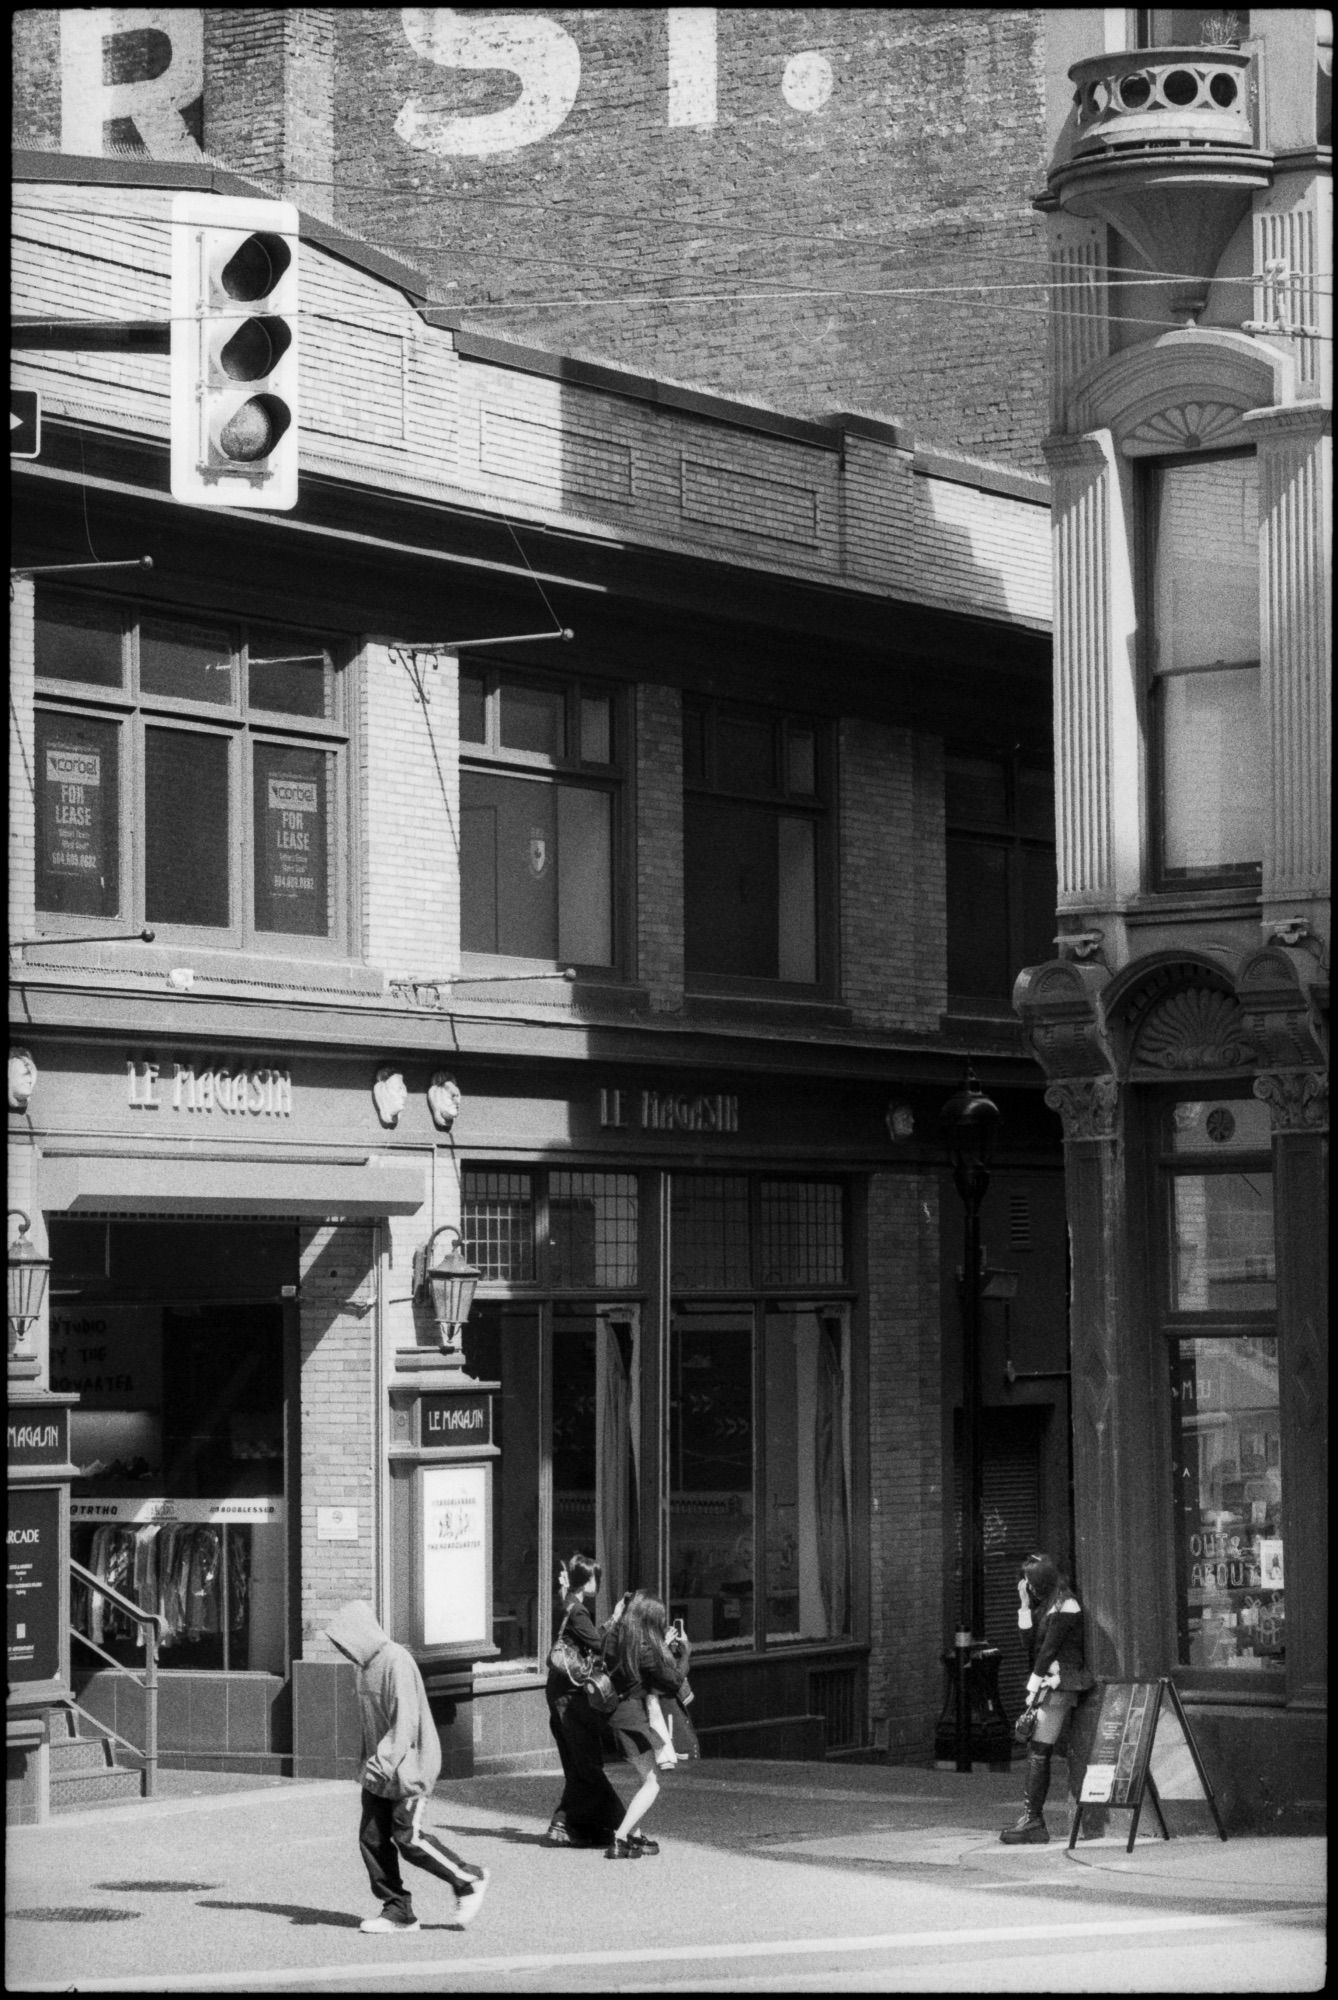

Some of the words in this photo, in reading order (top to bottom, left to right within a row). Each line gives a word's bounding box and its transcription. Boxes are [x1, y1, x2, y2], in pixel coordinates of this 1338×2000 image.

[61, 785, 85, 804] FOR
[279, 785, 314, 802] corbel
[55, 805, 92, 827] LEASE
[282, 811, 304, 830] FOR
[277, 830, 310, 851] LEASE
[127, 1061, 161, 1106] LE
[173, 1063, 292, 1114] MAGASIN
[600, 1088, 628, 1127] LE
[642, 1090, 739, 1132] MAGASIN
[429, 1410, 441, 1431] LE
[442, 1409, 484, 1431] MAGASIN
[7, 1426, 59, 1448] MAGASIN
[1190, 1533, 1228, 1557] OUT
[1191, 1563, 1260, 1587] ABOUT
